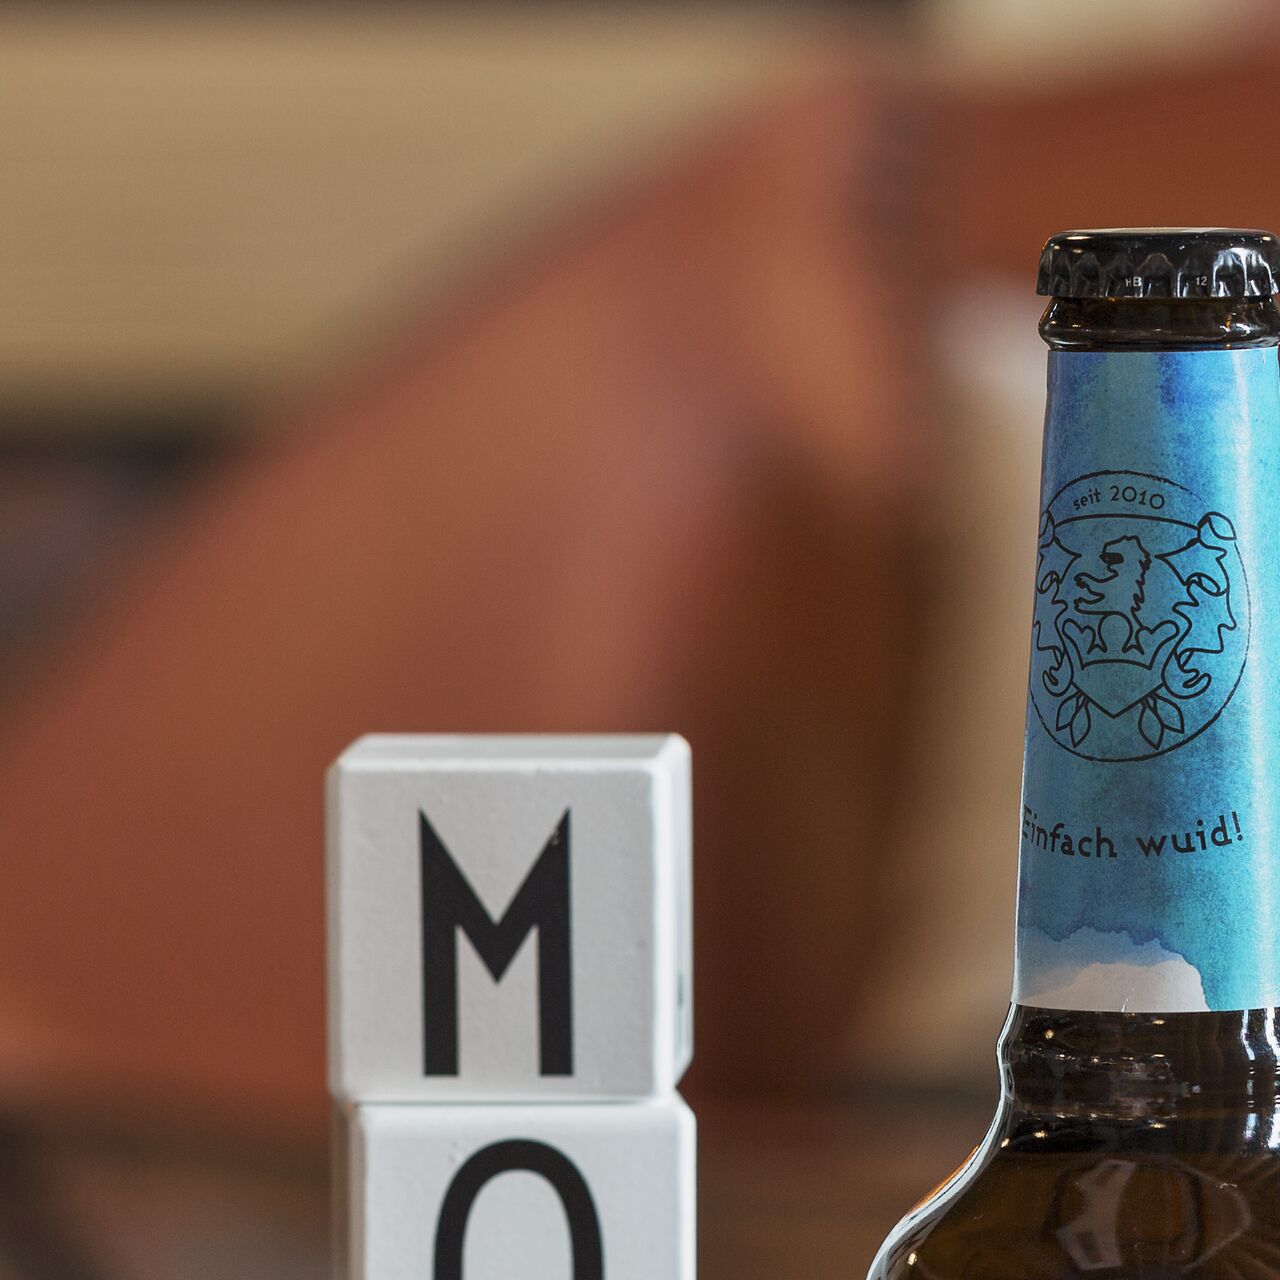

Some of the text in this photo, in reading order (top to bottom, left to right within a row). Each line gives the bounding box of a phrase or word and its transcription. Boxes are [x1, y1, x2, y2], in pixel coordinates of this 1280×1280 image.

[1073, 485, 1166, 511] seit 2010
[1022, 803, 1244, 858] Einfach wuid!
